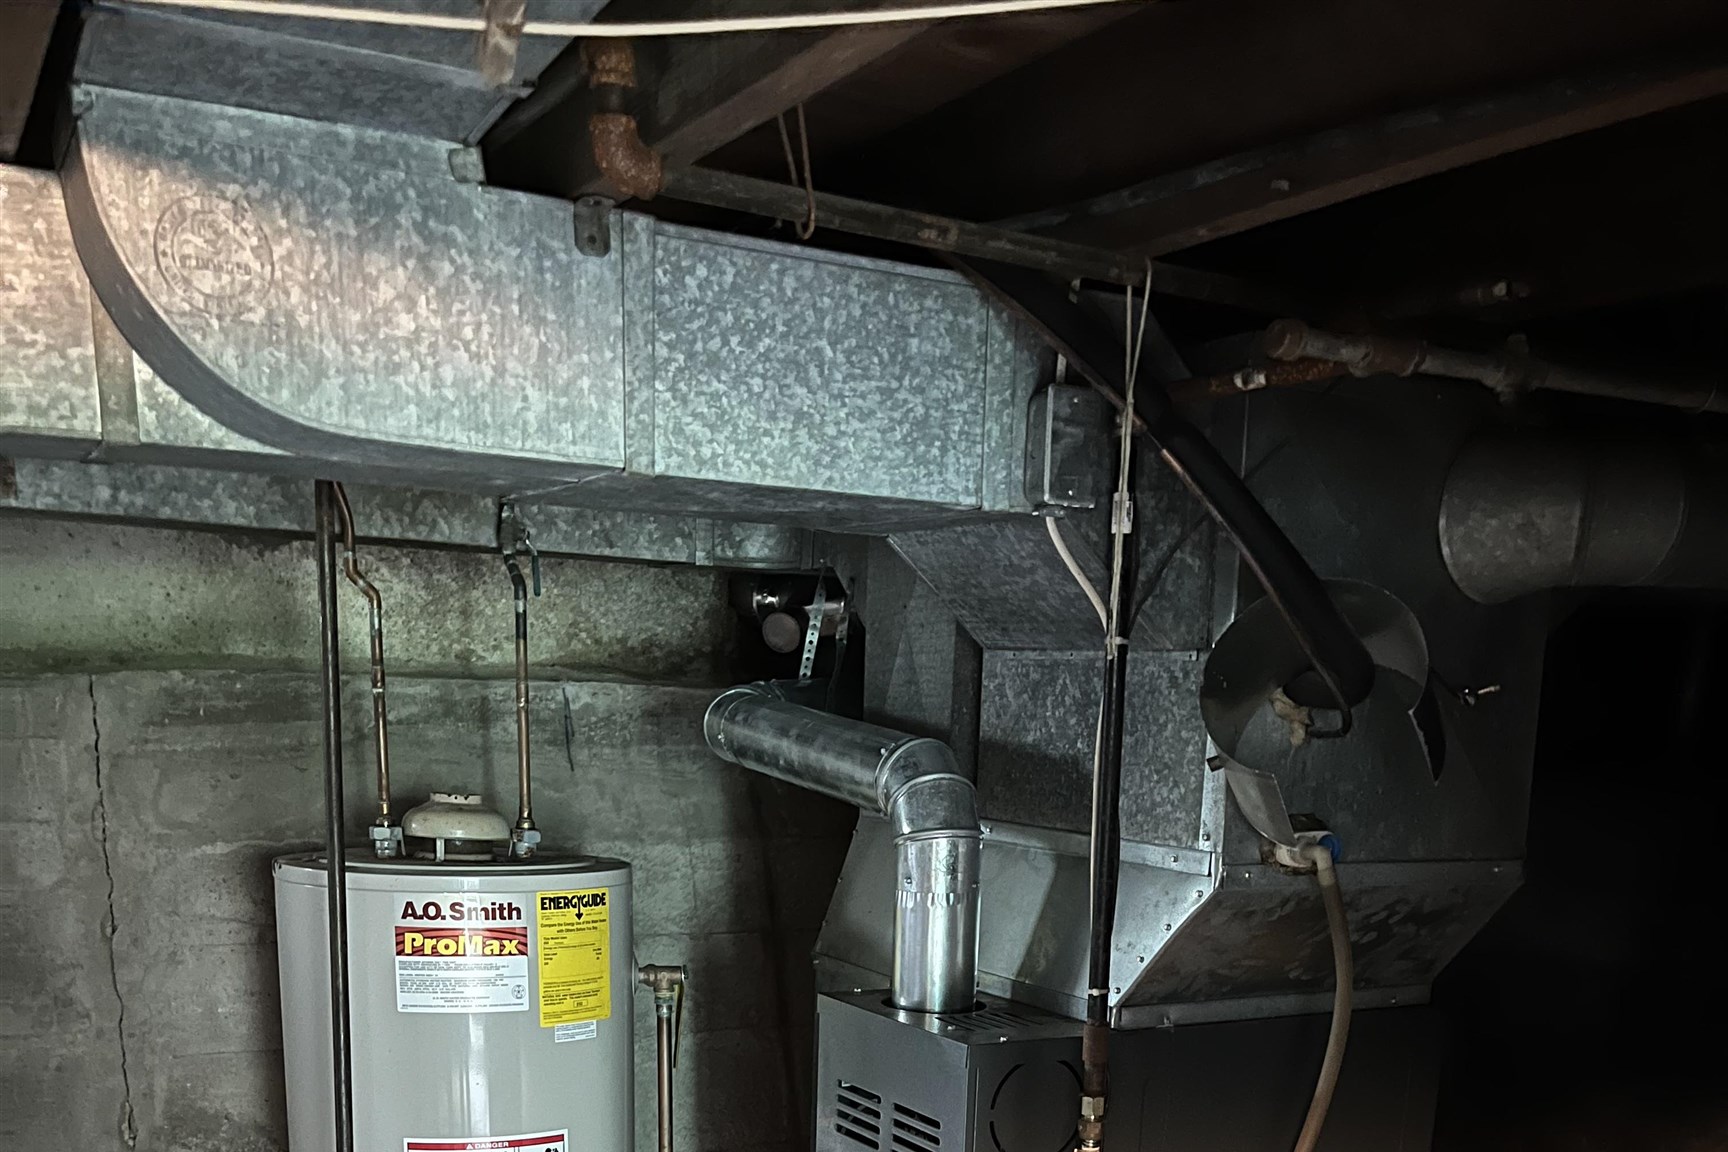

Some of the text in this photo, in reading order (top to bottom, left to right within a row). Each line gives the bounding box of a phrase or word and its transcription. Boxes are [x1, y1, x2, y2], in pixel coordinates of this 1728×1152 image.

[401, 901, 447, 920] A.O.
[449, 902, 522, 921] Smith
[404, 932, 519, 955] ProMax
[474, 1141, 509, 1149] DANGER
